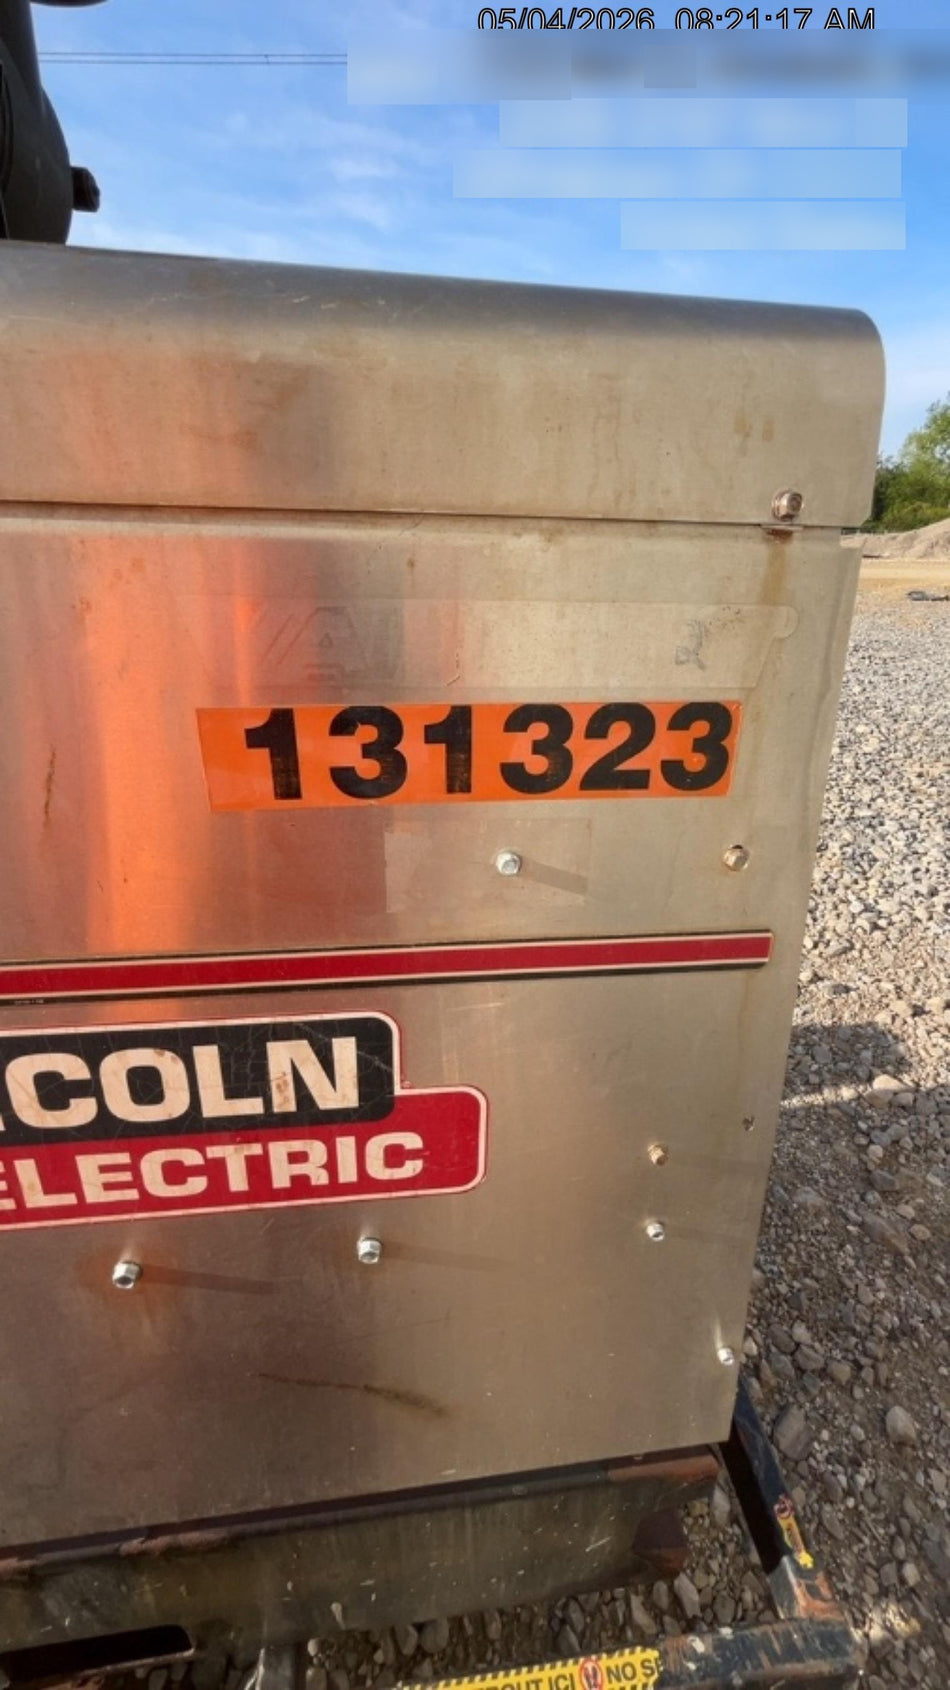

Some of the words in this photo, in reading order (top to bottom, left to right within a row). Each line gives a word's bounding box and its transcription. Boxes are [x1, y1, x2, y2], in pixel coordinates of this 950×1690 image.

[244, 700, 733, 799] 131323
[0, 1036, 360, 1129] COLN
[0, 1131, 424, 1210] LECTRIC
[605, 1661, 638, 1684] NO
